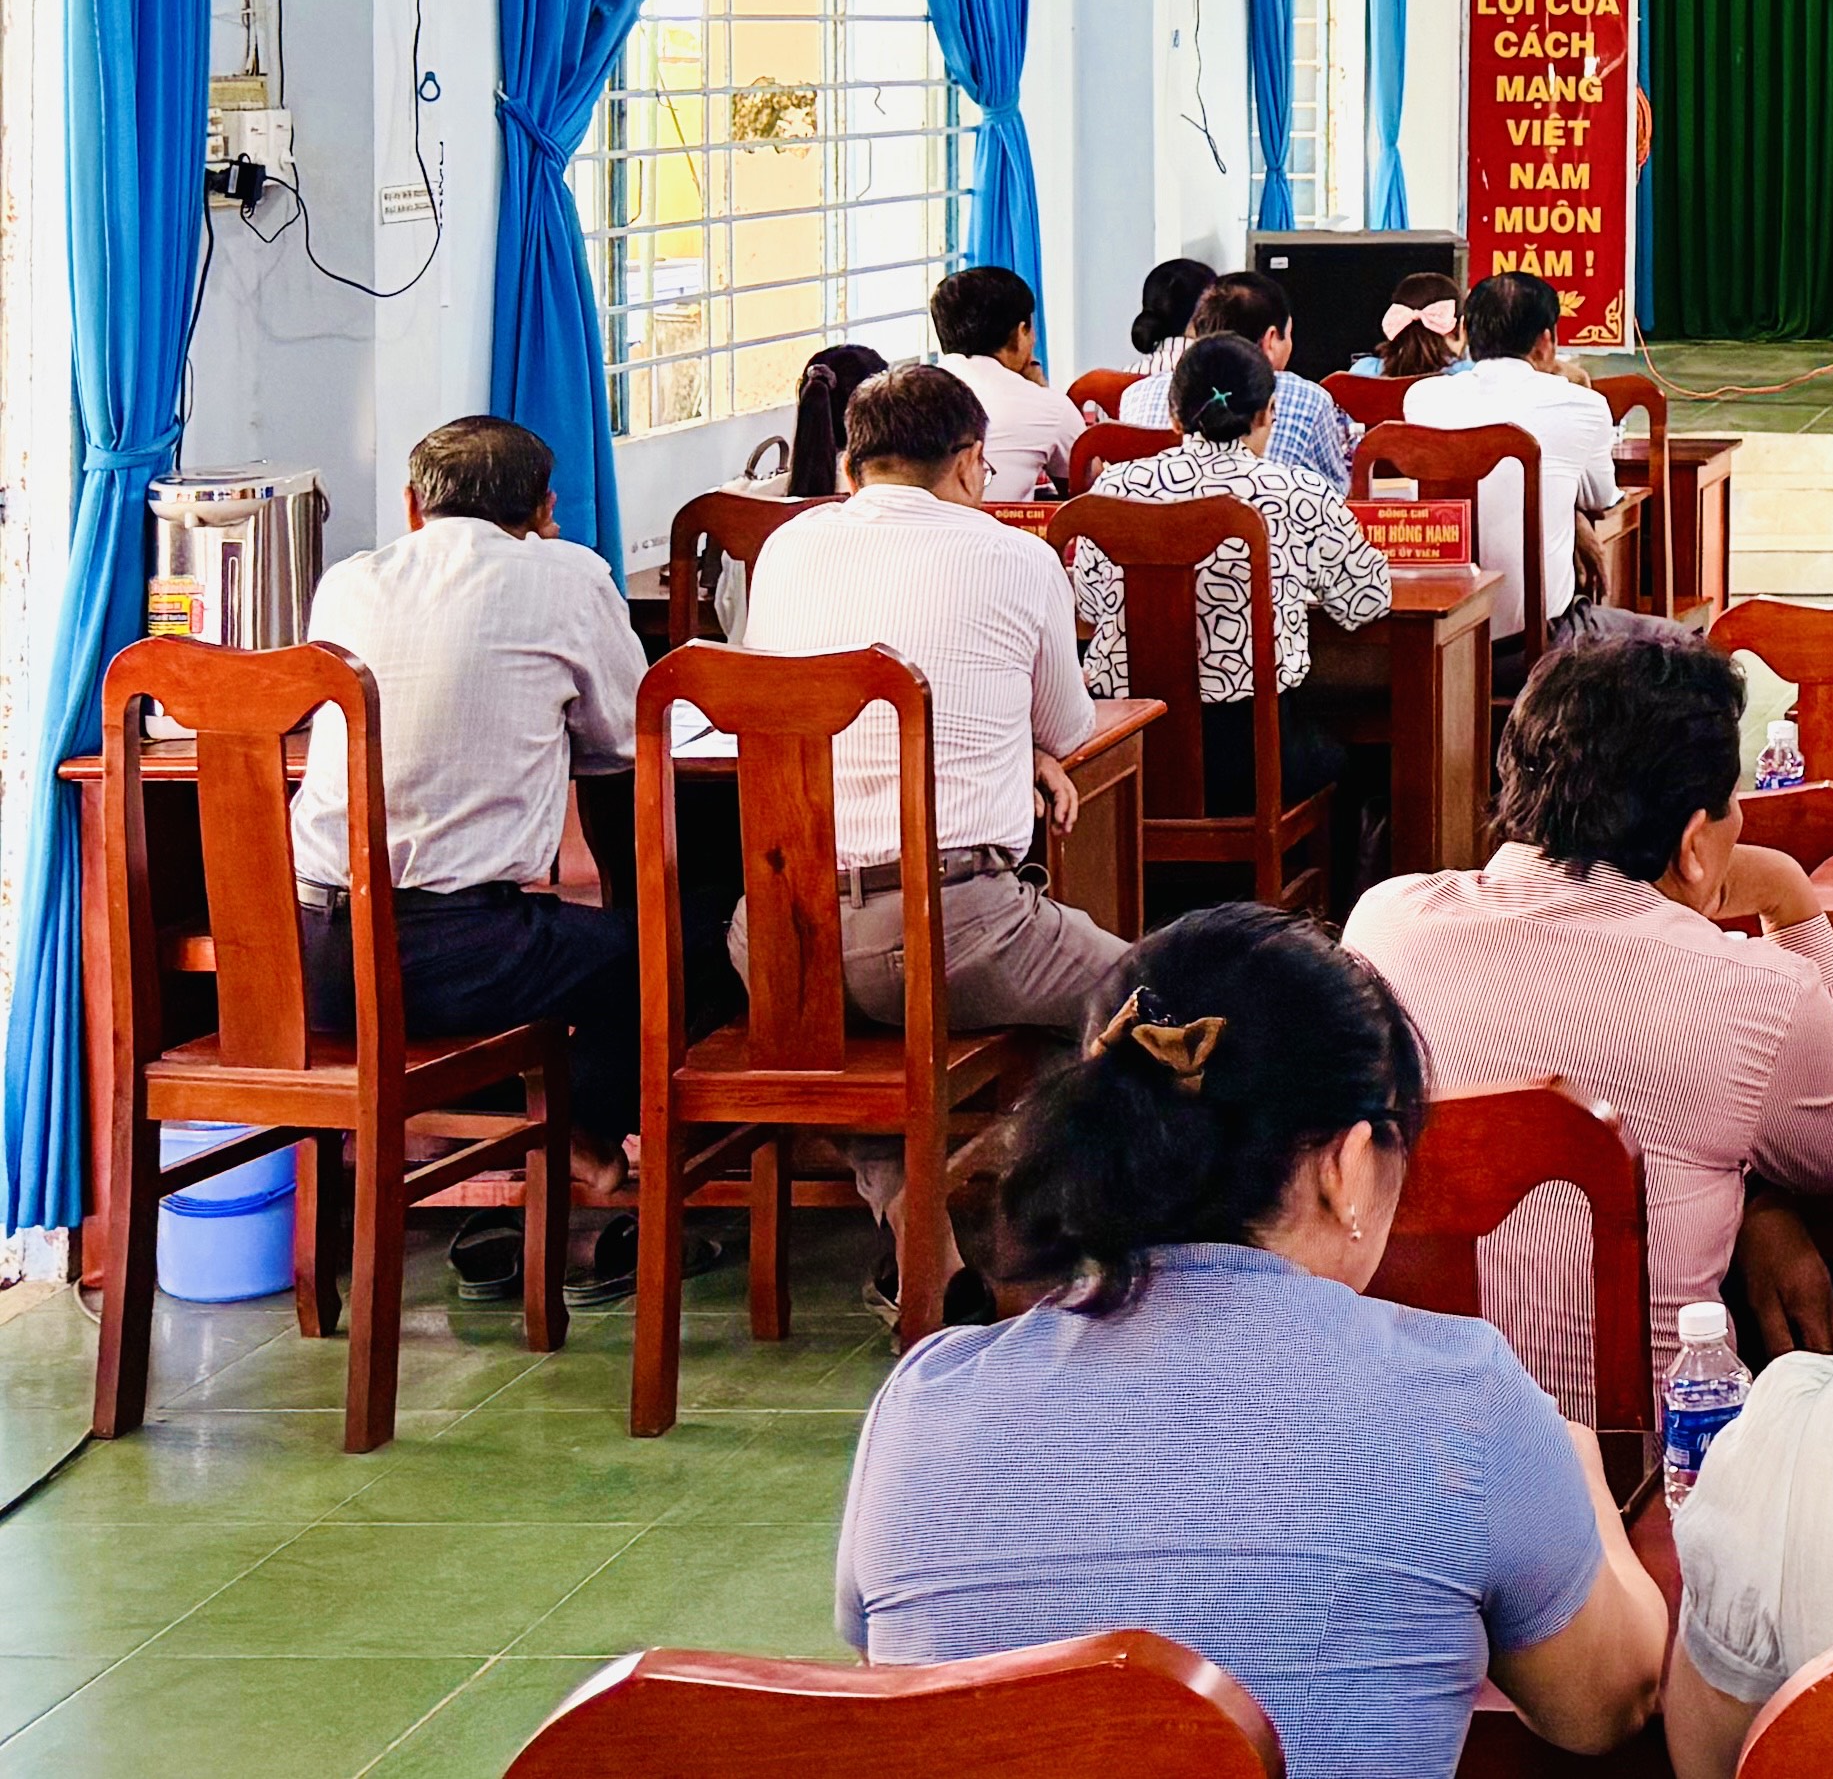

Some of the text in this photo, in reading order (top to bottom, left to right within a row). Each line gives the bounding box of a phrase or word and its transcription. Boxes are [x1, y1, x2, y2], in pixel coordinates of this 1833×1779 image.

[1494, 23, 1595, 58] CÁCH
[1496, 75, 1603, 110] MẠNG
[1506, 113, 1591, 154] VIỆT
[1509, 163, 1591, 190] NAM
[1494, 200, 1602, 233] MUÔN
[1491, 243, 1595, 277] NĂM !
